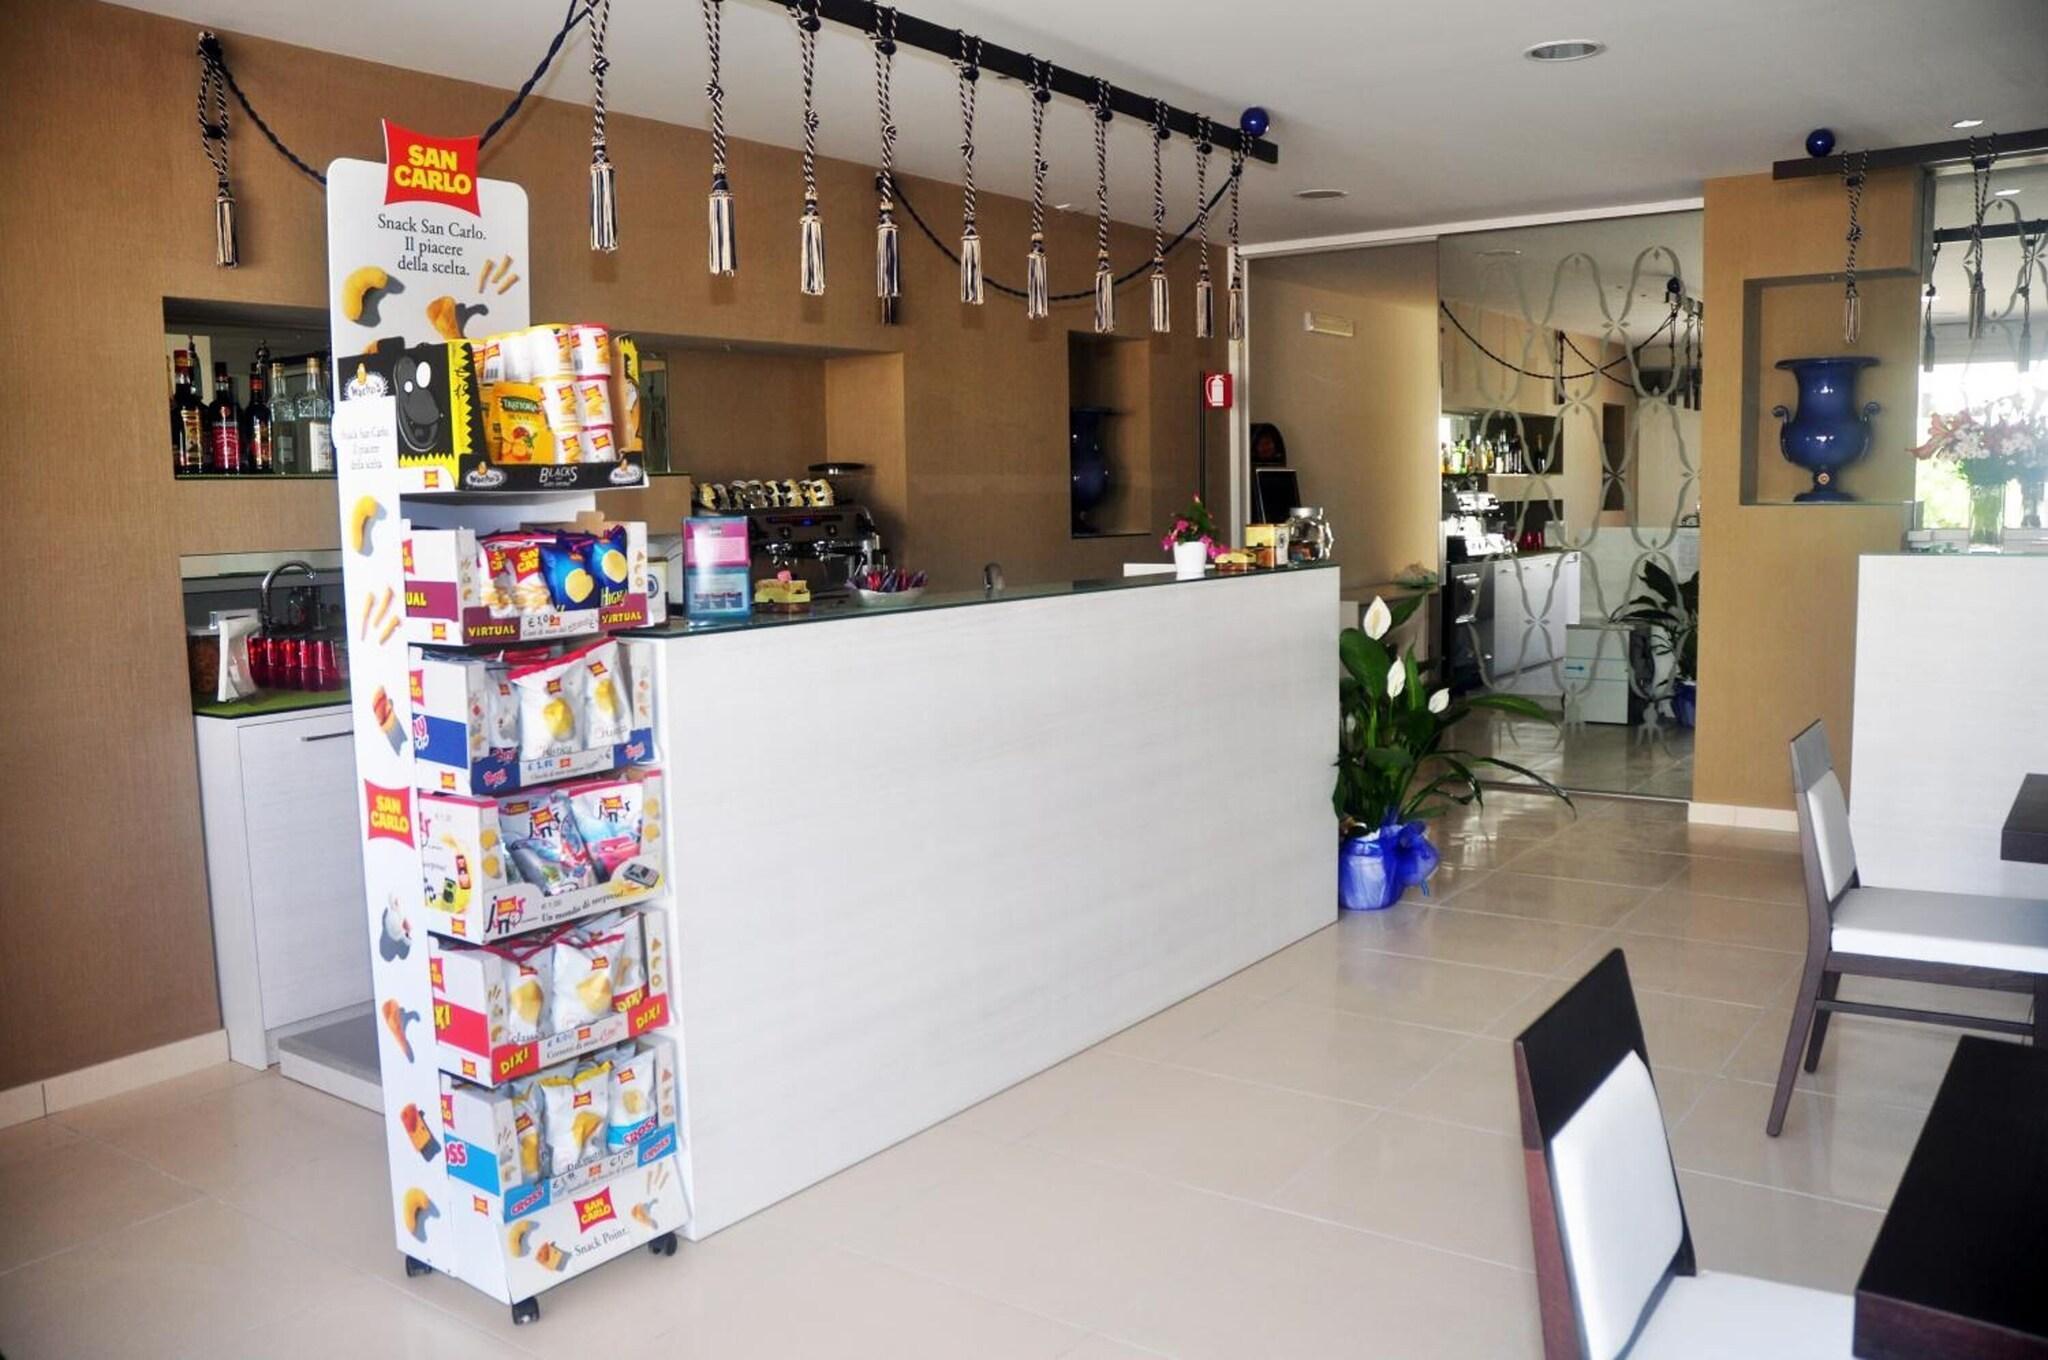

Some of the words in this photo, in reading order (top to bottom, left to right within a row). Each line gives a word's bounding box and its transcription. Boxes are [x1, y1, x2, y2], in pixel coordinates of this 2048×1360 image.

[407, 144, 458, 172] SAN
[393, 164, 473, 196] CARLO
[377, 213, 418, 233] Snack
[421, 219, 445, 236] San
[448, 222, 487, 241] Carlo.
[404, 235, 415, 252] Il
[419, 238, 463, 257] piacere
[397, 254, 429, 273] della
[432, 260, 470, 277] scelta.
[601, 611, 643, 625] VIRTUAL
[468, 625, 516, 636] VIRTUAL
[375, 795, 402, 815] SAN
[370, 811, 410, 834] CARLO
[636, 1004, 661, 1031] DIXI
[500, 1047, 530, 1075] DIXI
[446, 1142, 467, 1165] SS
[581, 1204, 611, 1224] CARLO
[584, 1197, 604, 1212] SAN
[574, 1236, 600, 1256] Snack
